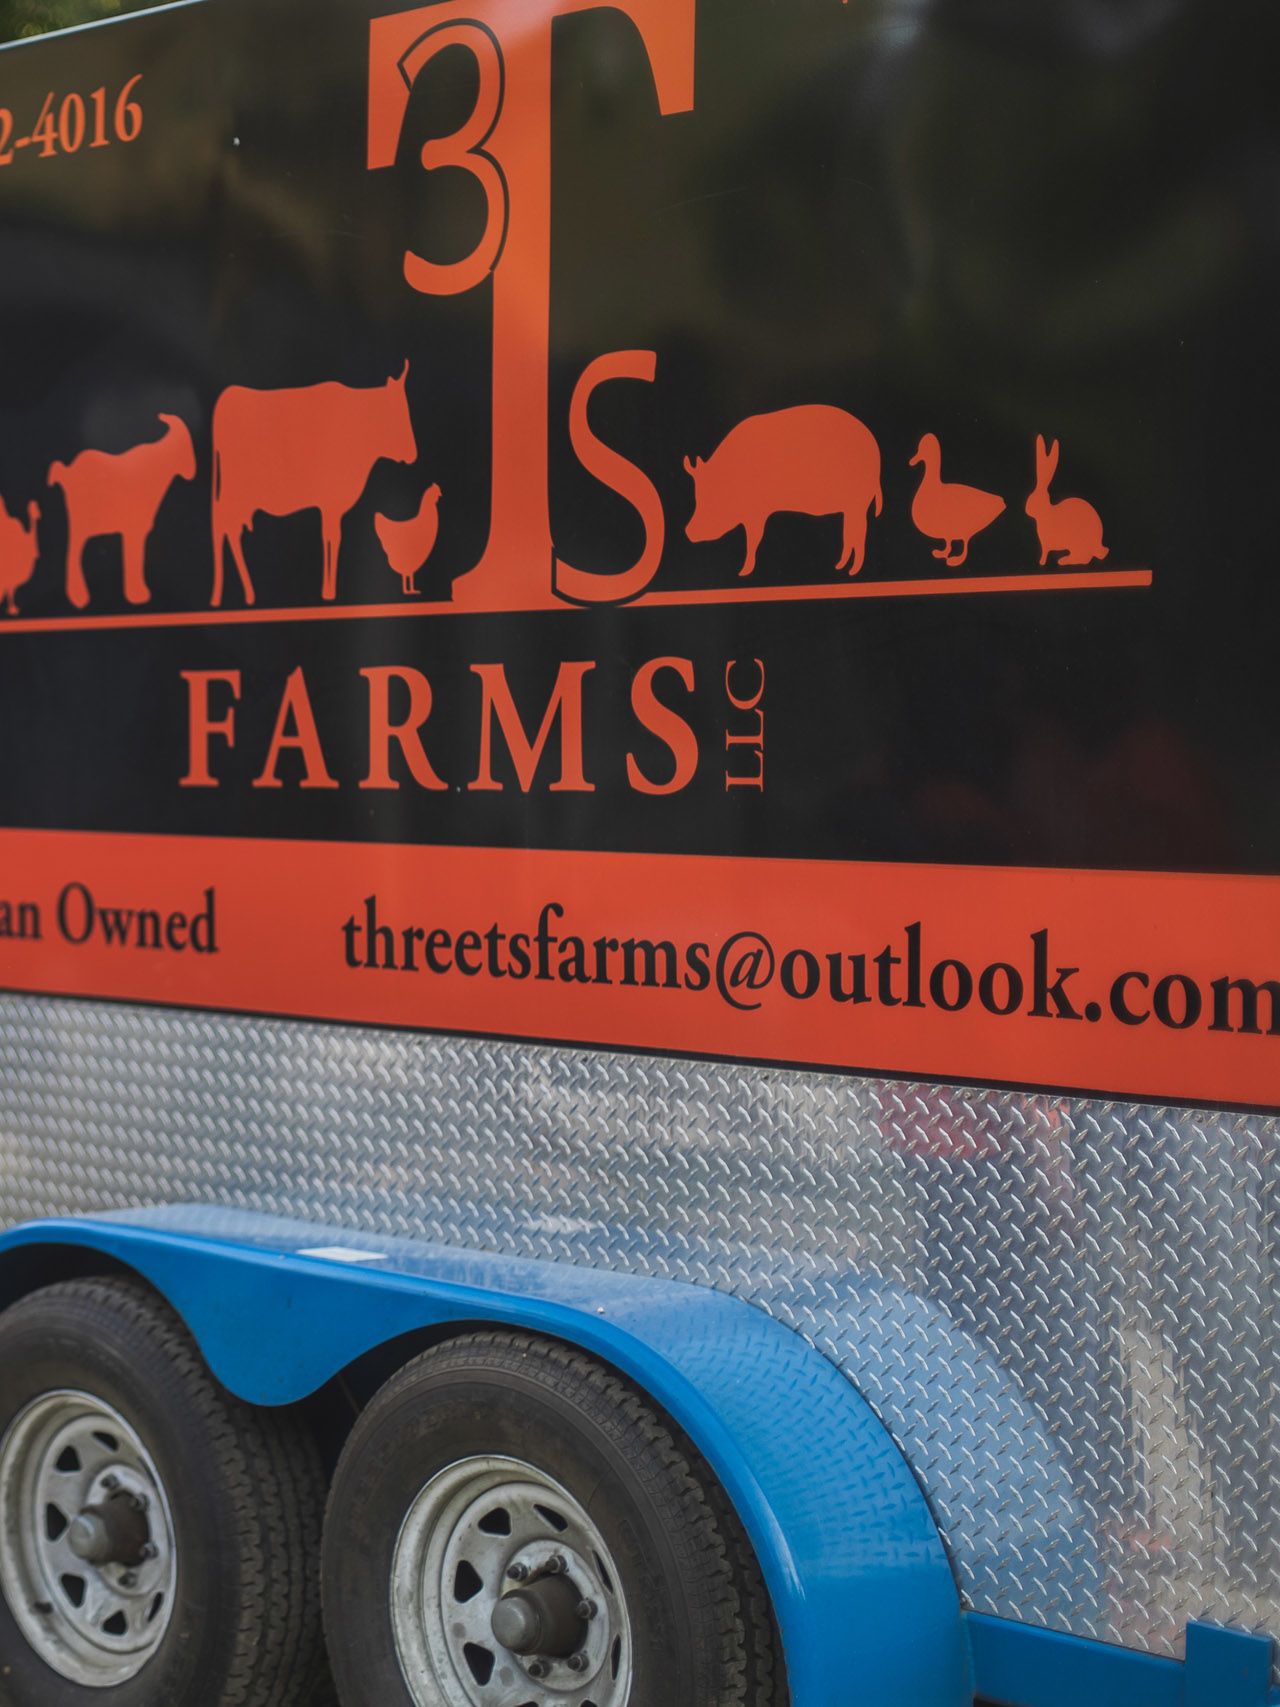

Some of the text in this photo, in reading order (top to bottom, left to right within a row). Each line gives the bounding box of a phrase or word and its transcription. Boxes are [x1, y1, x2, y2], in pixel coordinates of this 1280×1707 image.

[179, 656, 699, 795] FARMS
[725, 658, 766, 792] LLC
[56, 882, 218, 954] Owned
[340, 895, 1280, 1037] threetsfarms@outlook.com
